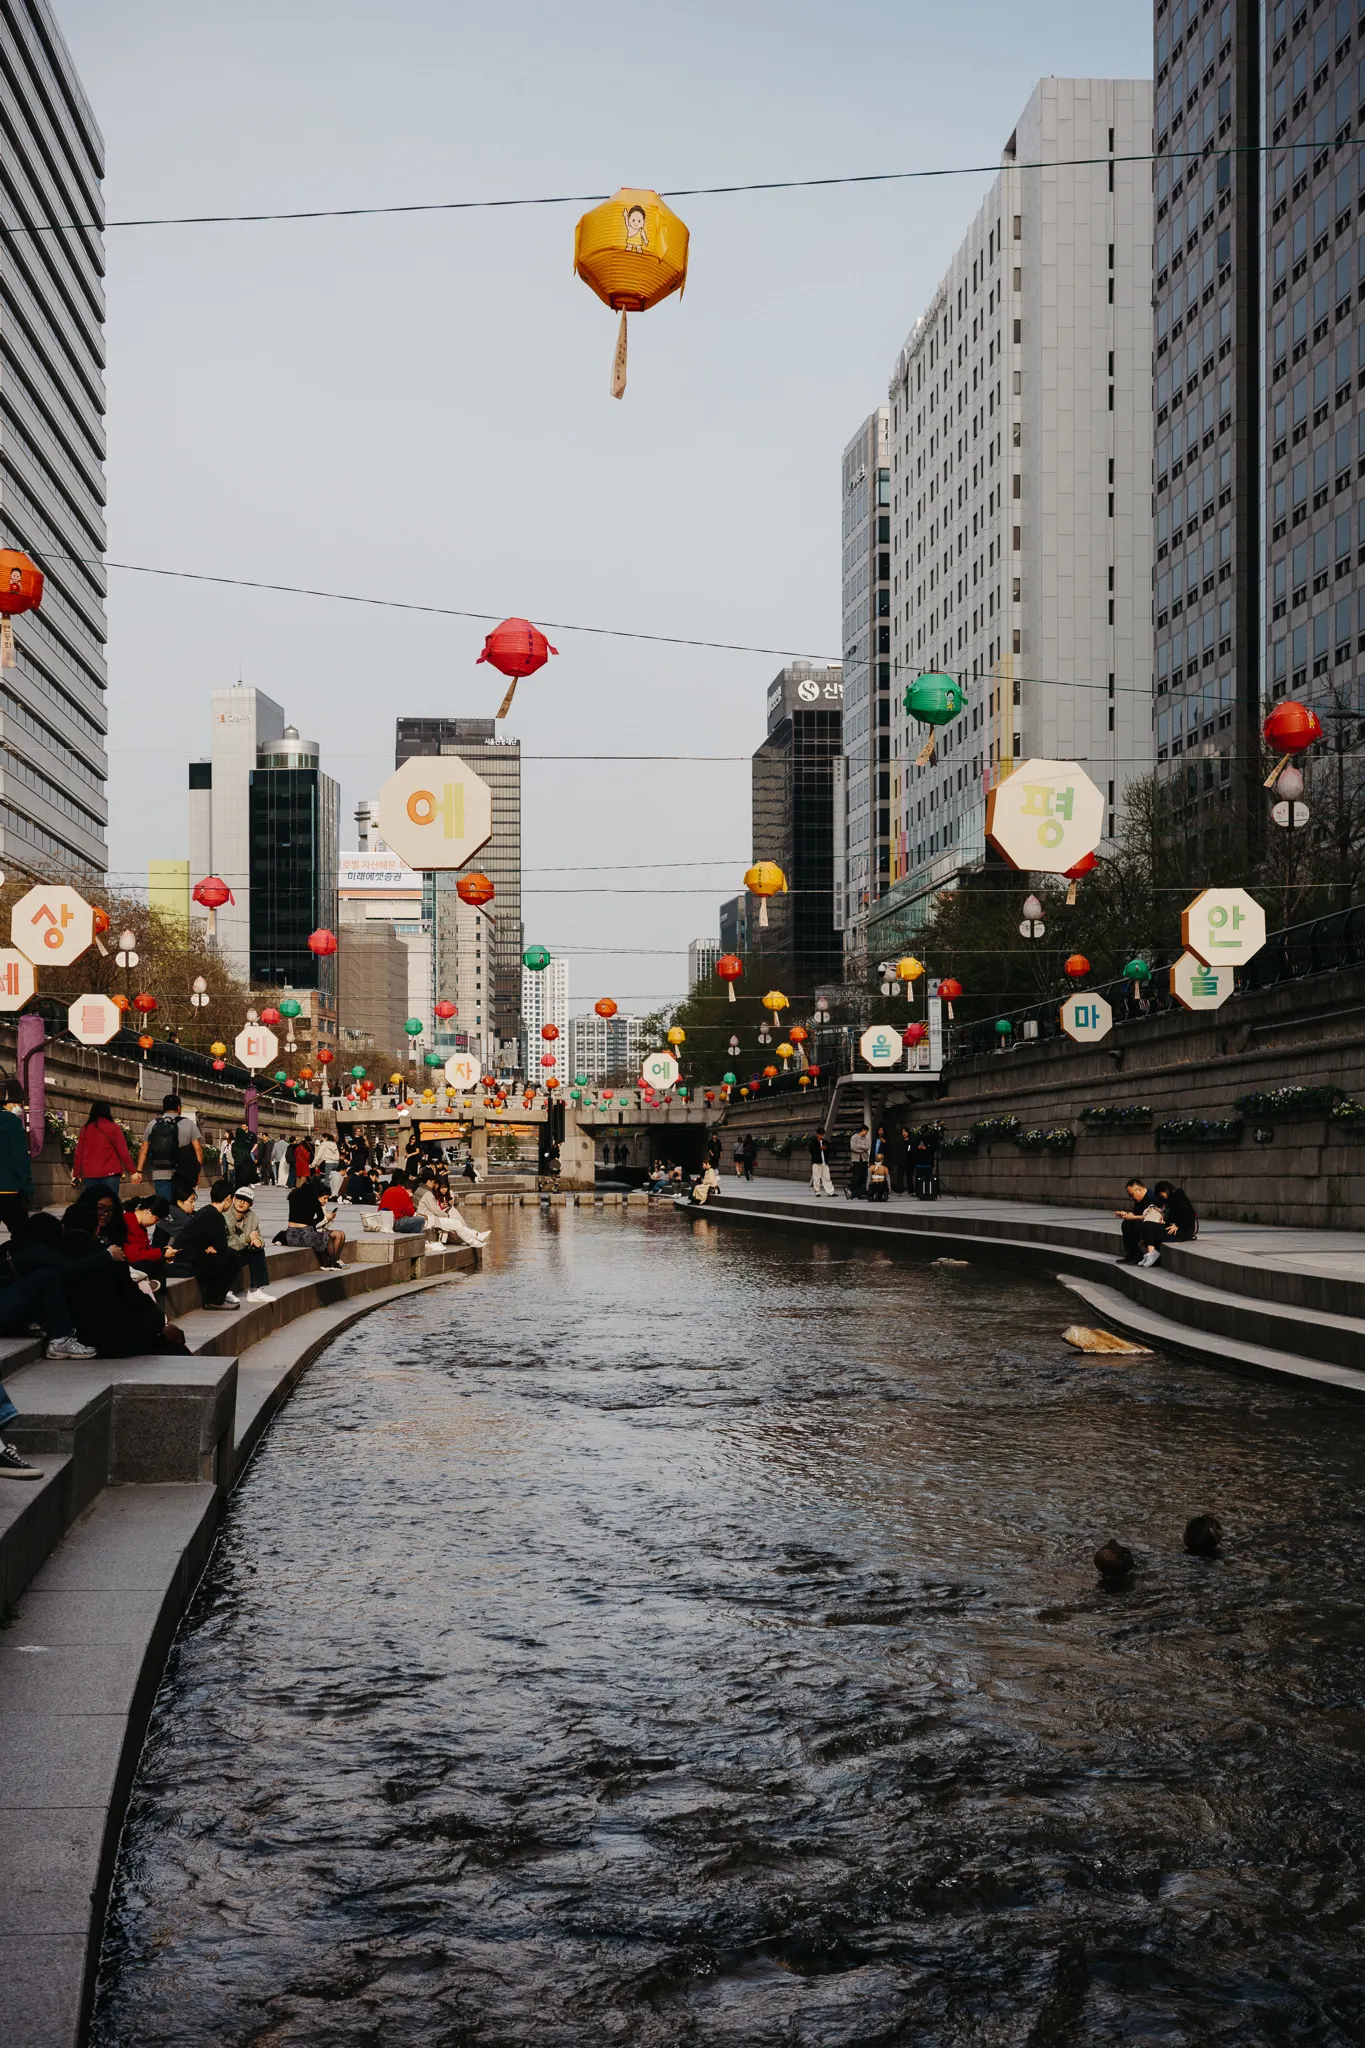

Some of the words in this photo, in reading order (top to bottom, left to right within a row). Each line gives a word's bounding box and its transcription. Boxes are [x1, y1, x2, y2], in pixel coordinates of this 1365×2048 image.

[407, 783, 465, 839] 에
[1021, 785, 1075, 848] 평
[347, 872, 402, 881] 미래에셋증권
[31, 904, 74, 949] 상
[1208, 906, 1245, 947] 안
[1190, 964, 1219, 996] 을
[1075, 1004, 1101, 1029] 마
[247, 1036, 267, 1057] 비
[872, 1034, 892, 1058] 음
[454, 1062, 473, 1081] 자
[652, 1062, 671, 1080] 에
